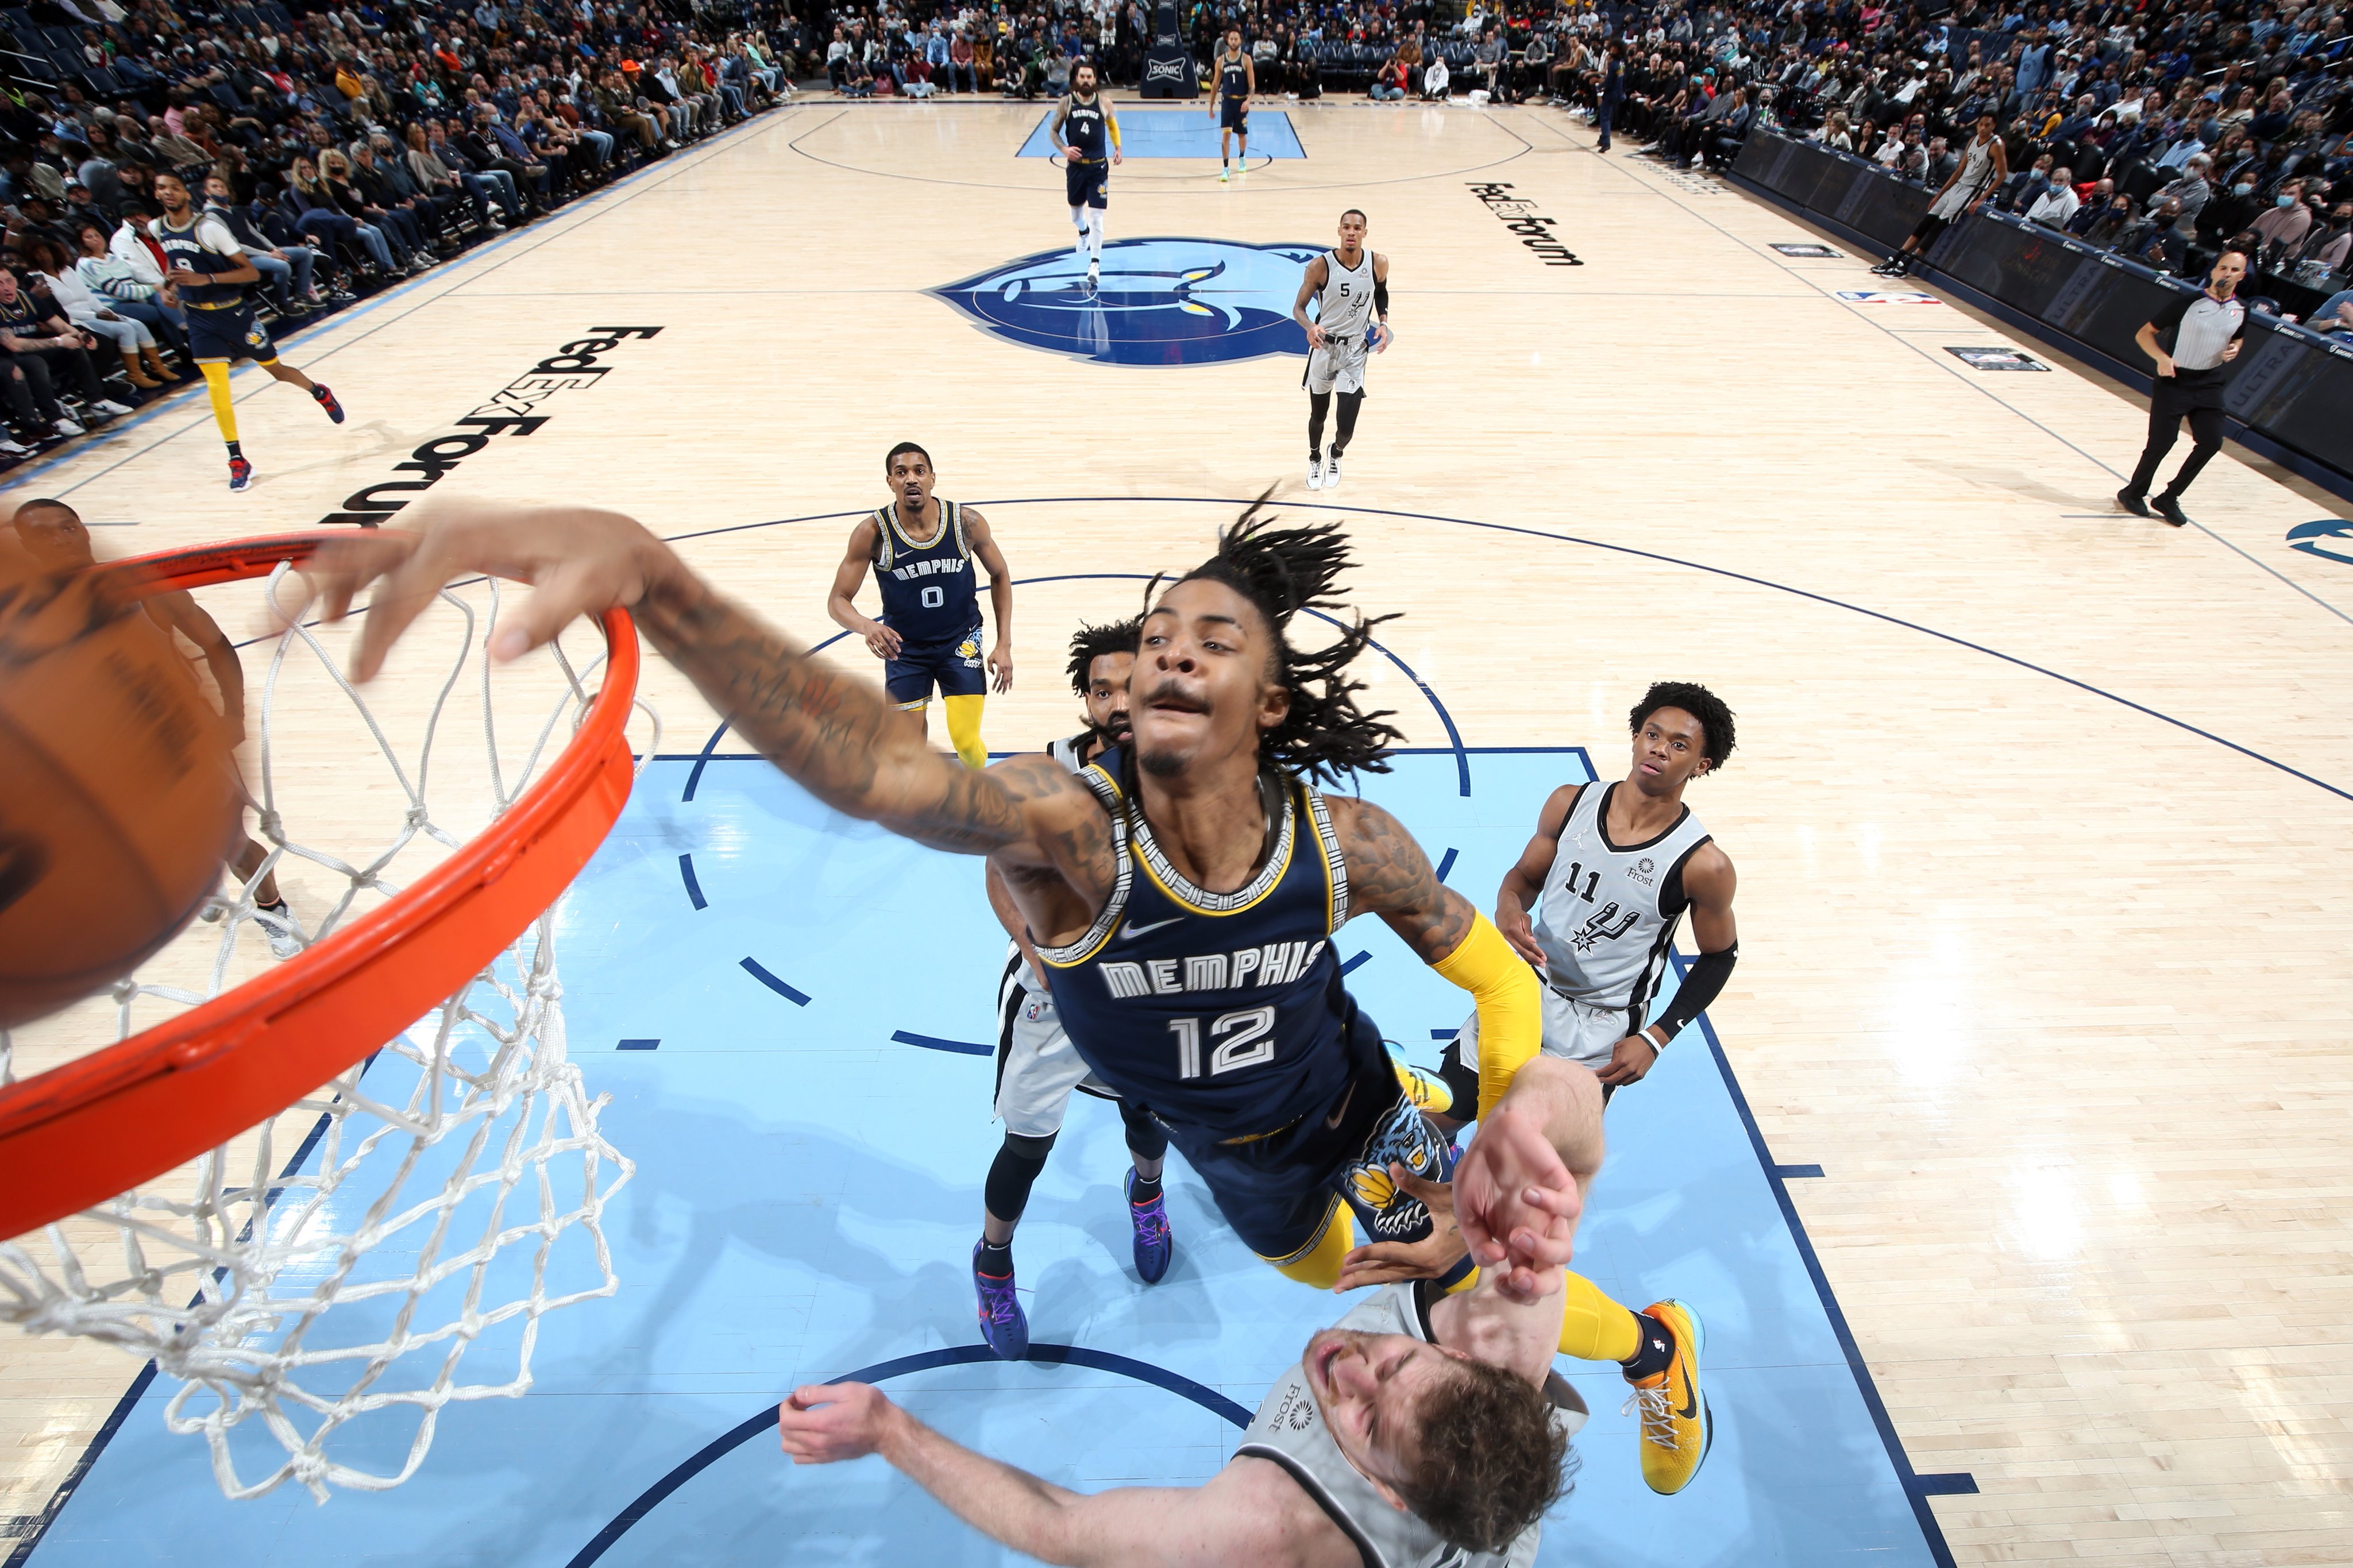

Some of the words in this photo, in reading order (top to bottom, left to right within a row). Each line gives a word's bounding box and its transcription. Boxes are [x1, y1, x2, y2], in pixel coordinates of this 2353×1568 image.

[1152, 65, 1180, 75] SONIC
[1231, 73, 1236, 84] 1
[1080, 121, 1090, 135] 4
[1968, 152, 1977, 161] 24
[1464, 182, 1584, 265] FedExForum
[1340, 283, 1350, 297] 5
[2054, 266, 2100, 319] ULTRA
[2232, 345, 2296, 406] ULTRA
[892, 558, 966, 581] MEMPHIS
[921, 586, 944, 608] 0
[1564, 860, 1603, 906] 11
[1627, 867, 1654, 887] Frost
[1098, 940, 1326, 999] MEMPHIS
[1168, 1005, 1277, 1080] 12
[1268, 1381, 1302, 1434] Frost
